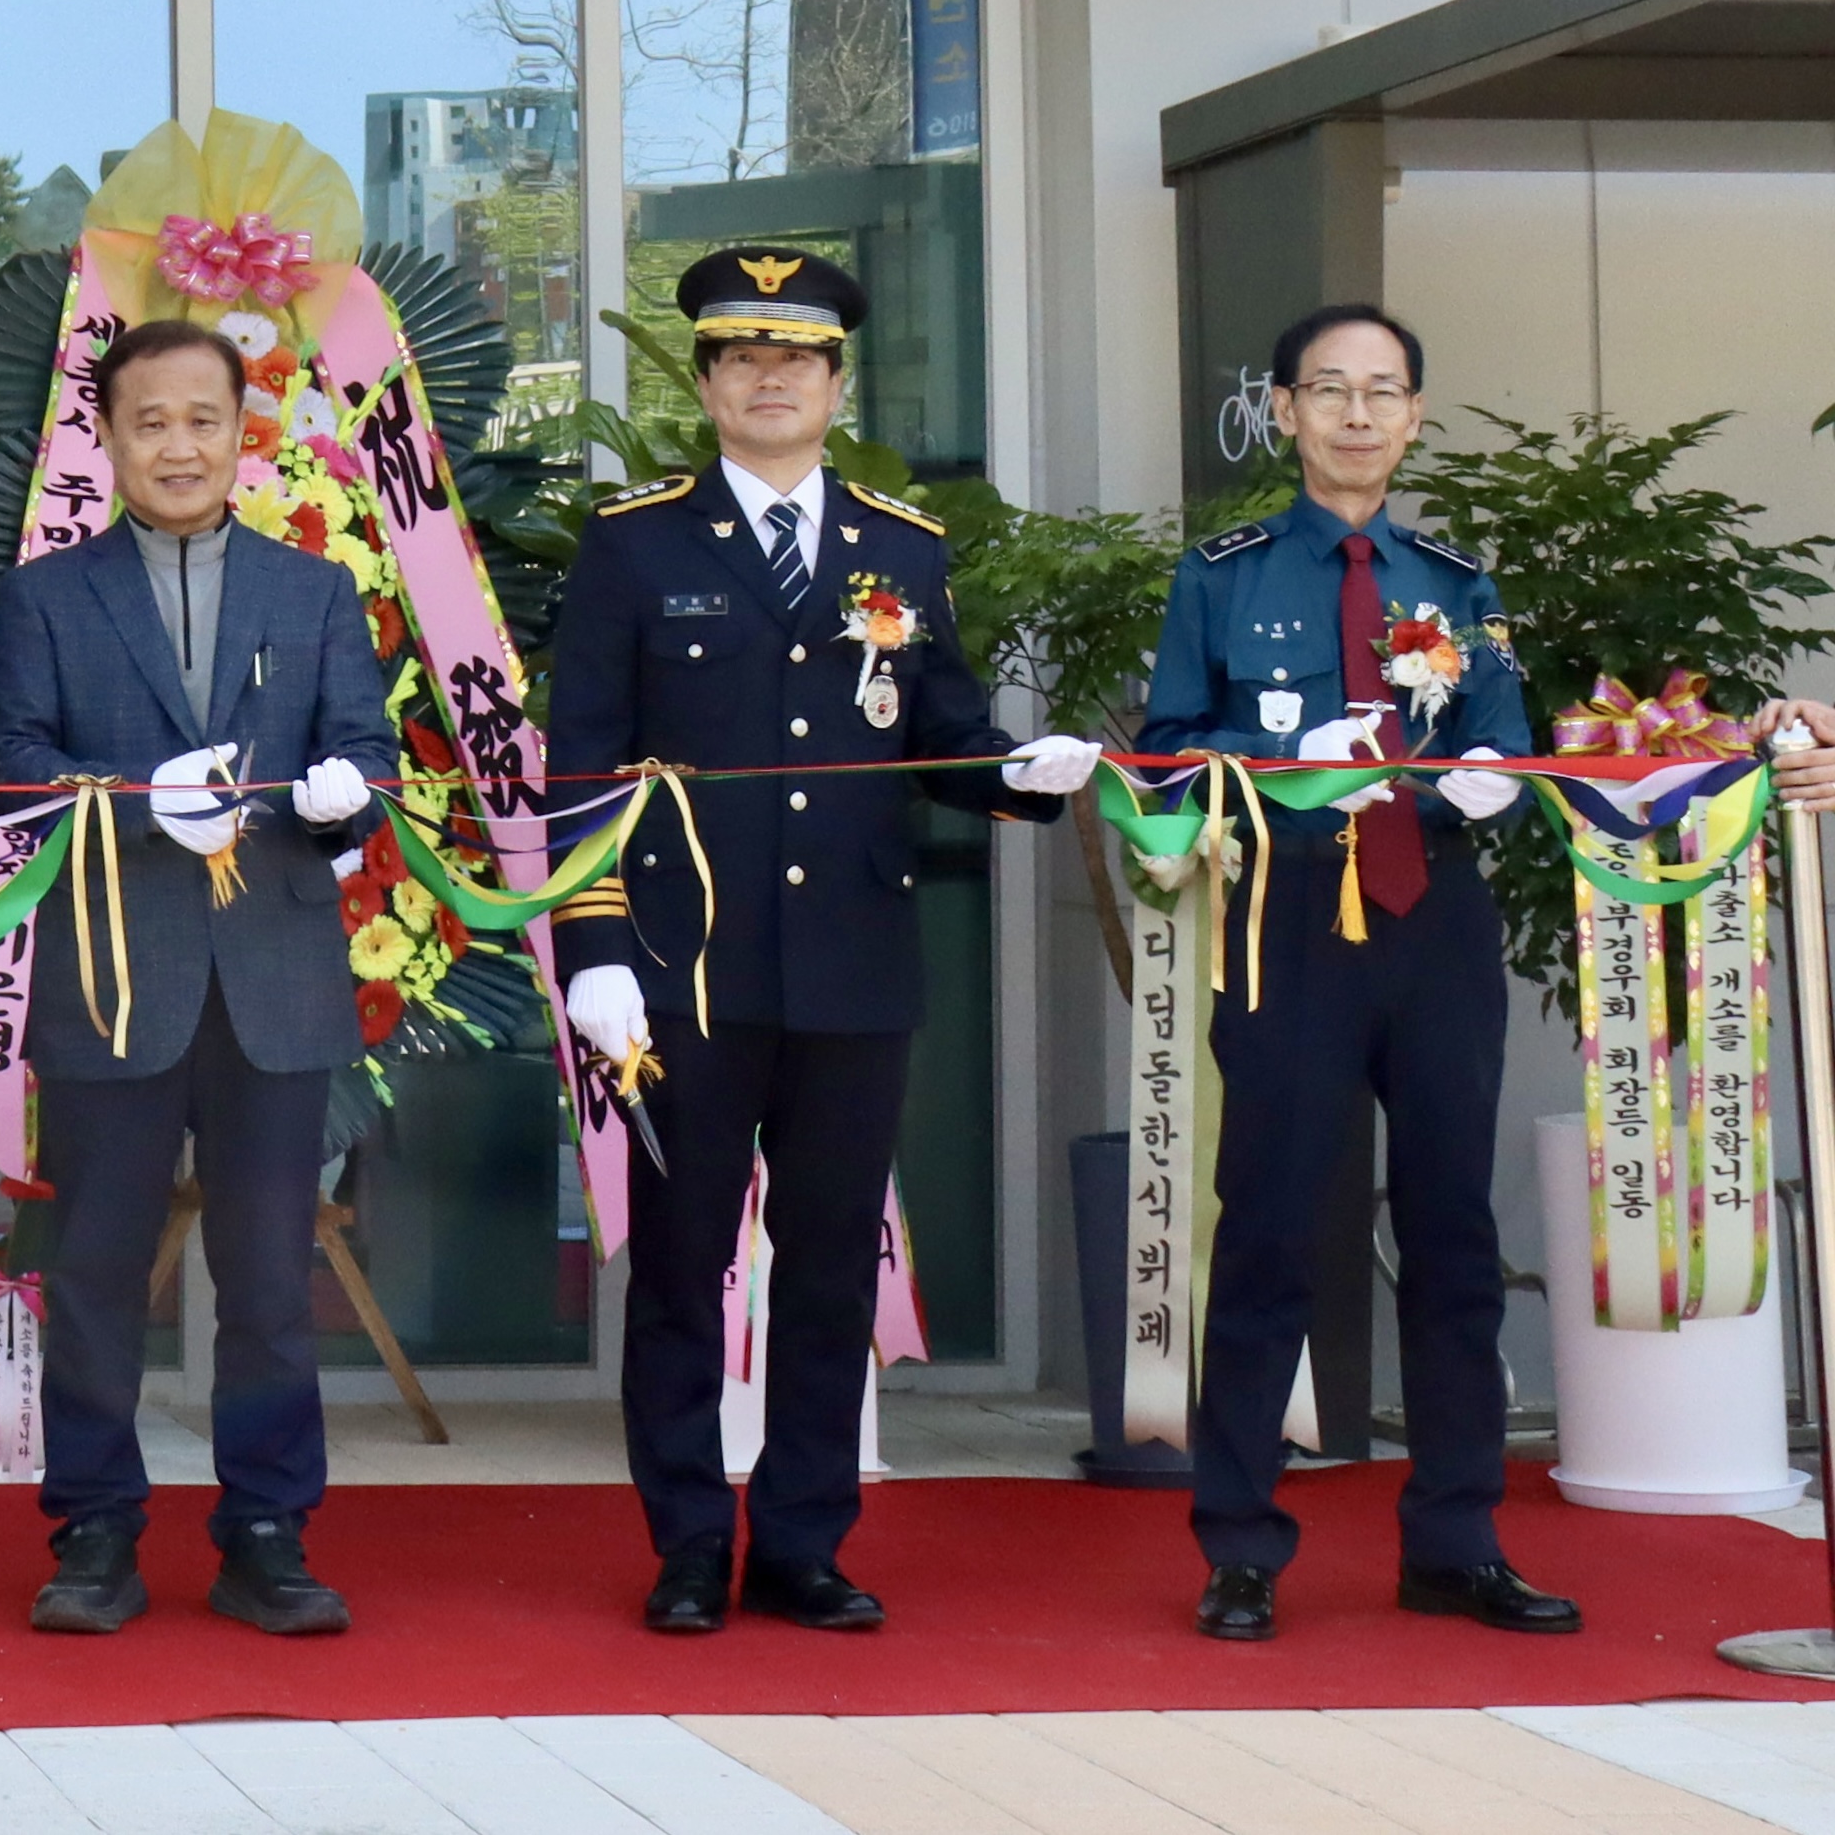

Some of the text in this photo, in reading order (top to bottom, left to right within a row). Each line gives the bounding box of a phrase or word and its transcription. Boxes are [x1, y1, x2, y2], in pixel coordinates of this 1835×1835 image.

[1708, 967, 1747, 1053] 개소를
[1603, 1046, 1648, 1137] 회장등
[1710, 1072, 1751, 1212] 환영합니다
[1610, 1159, 1652, 1220] 일동
